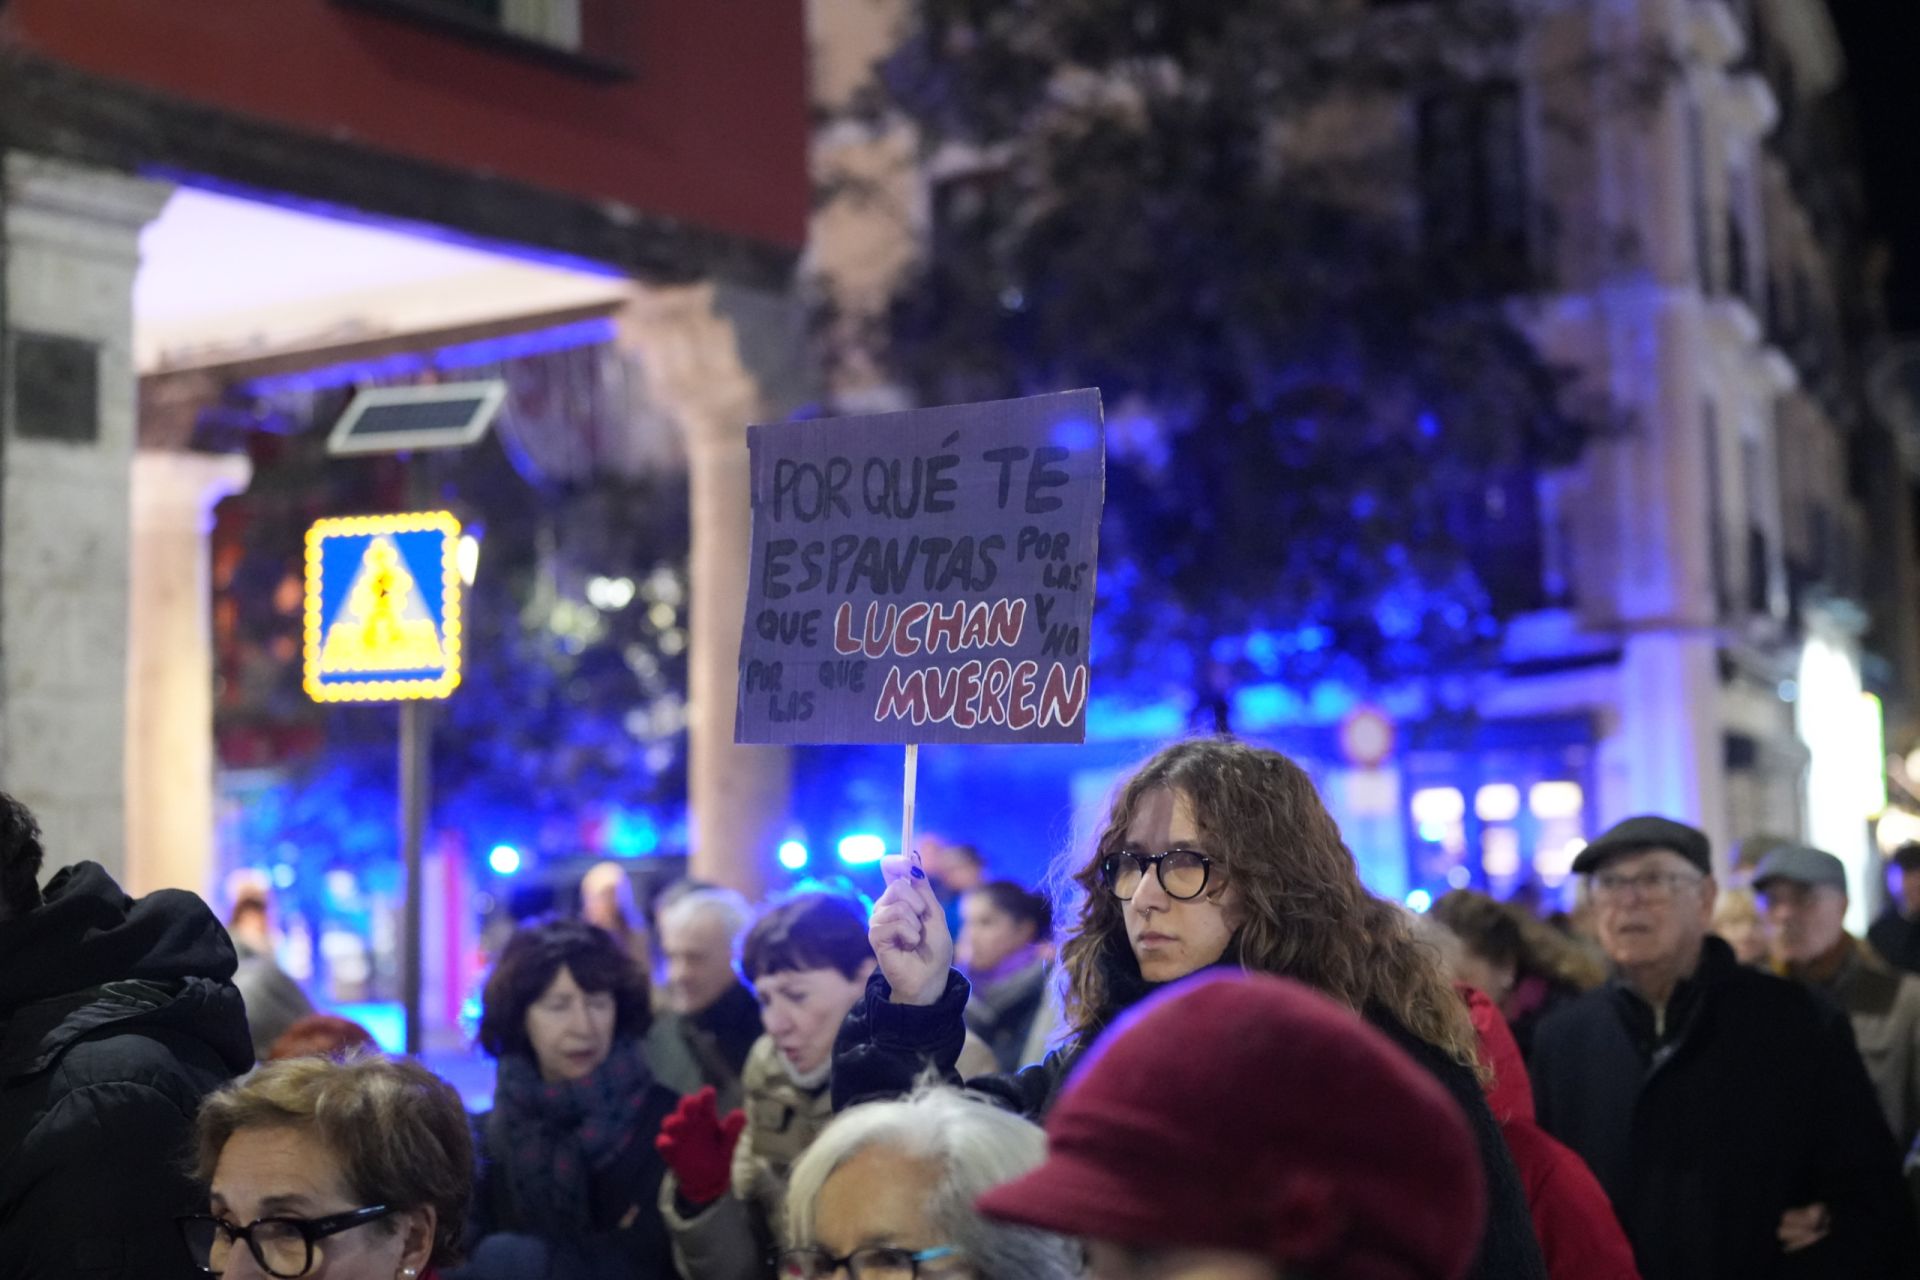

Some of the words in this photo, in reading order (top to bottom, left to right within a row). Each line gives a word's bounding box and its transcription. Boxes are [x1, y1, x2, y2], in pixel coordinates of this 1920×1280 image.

[982, 445, 1071, 514] TE
[762, 534, 1006, 599] ESPANTAS
[1018, 526, 1069, 562] POR
[1042, 562, 1088, 592] LAS
[755, 609, 822, 648] QUE
[834, 598, 1027, 658] LUCHAN
[1034, 592, 1056, 633] Y
[1041, 624, 1080, 658] NO
[874, 659, 1086, 731] MUEREN
